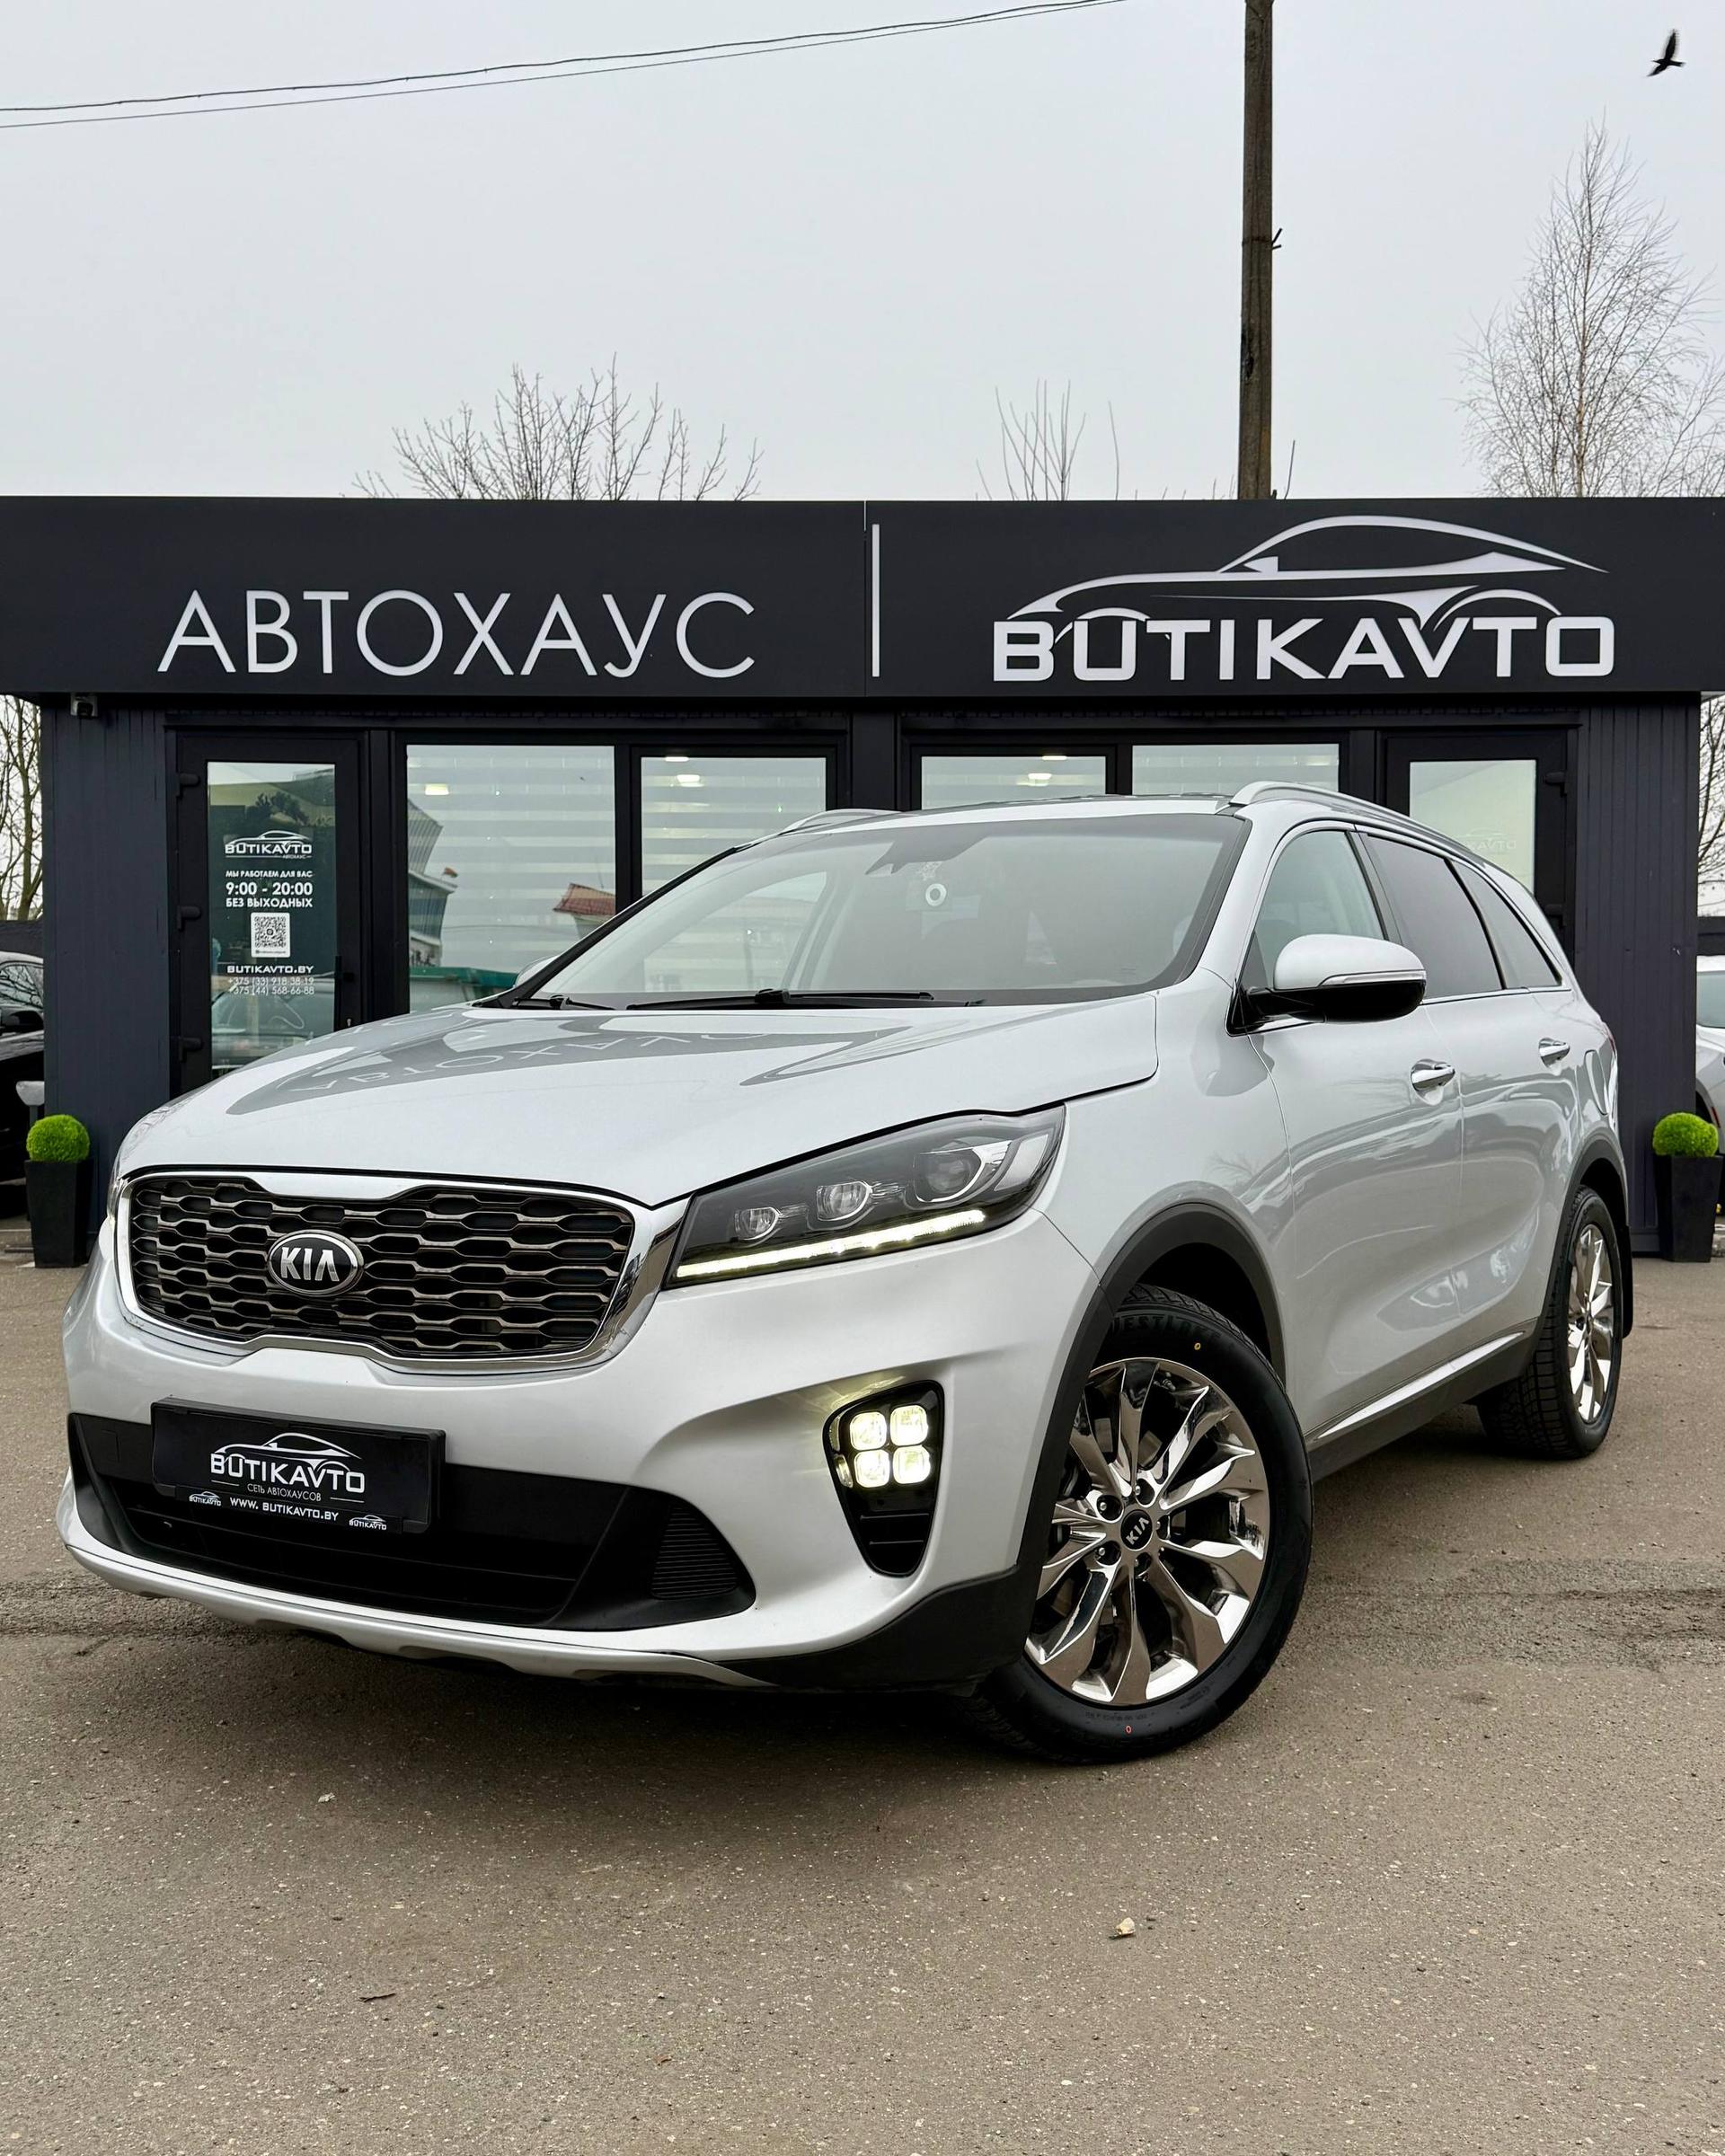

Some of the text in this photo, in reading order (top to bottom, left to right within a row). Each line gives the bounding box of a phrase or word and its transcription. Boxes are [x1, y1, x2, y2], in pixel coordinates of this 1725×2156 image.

[157, 589, 756, 679] АВТОХАУС
[993, 616, 1615, 683] BUTIKAVTO
[225, 843, 313, 854] BUTIKAVTO
[226, 870, 314, 879] МЫ РАБОТАЕМ ДЛЯ ВАС
[226, 881, 258, 896] 9:00
[272, 881, 314, 896] 20:00
[226, 897, 314, 909] БЕЗ ВЫХОДНЫХ
[226, 965, 314, 974] BUTIKAVTO.BY
[228, 976, 250, 985] +375
[252, 976, 269, 987] (33)
[271, 986, 314, 995] 568-66-88
[280, 1246, 341, 1282] KIA
[210, 1453, 365, 1493] BUTIKAVTO
[247, 1483, 322, 1502] СЕТЬ АВТОХАУСОВ
[189, 1495, 222, 1507] BUTIKAVTO
[349, 1519, 387, 1531] BUTIKAVTO
[1126, 1517, 1150, 1545] KIA
